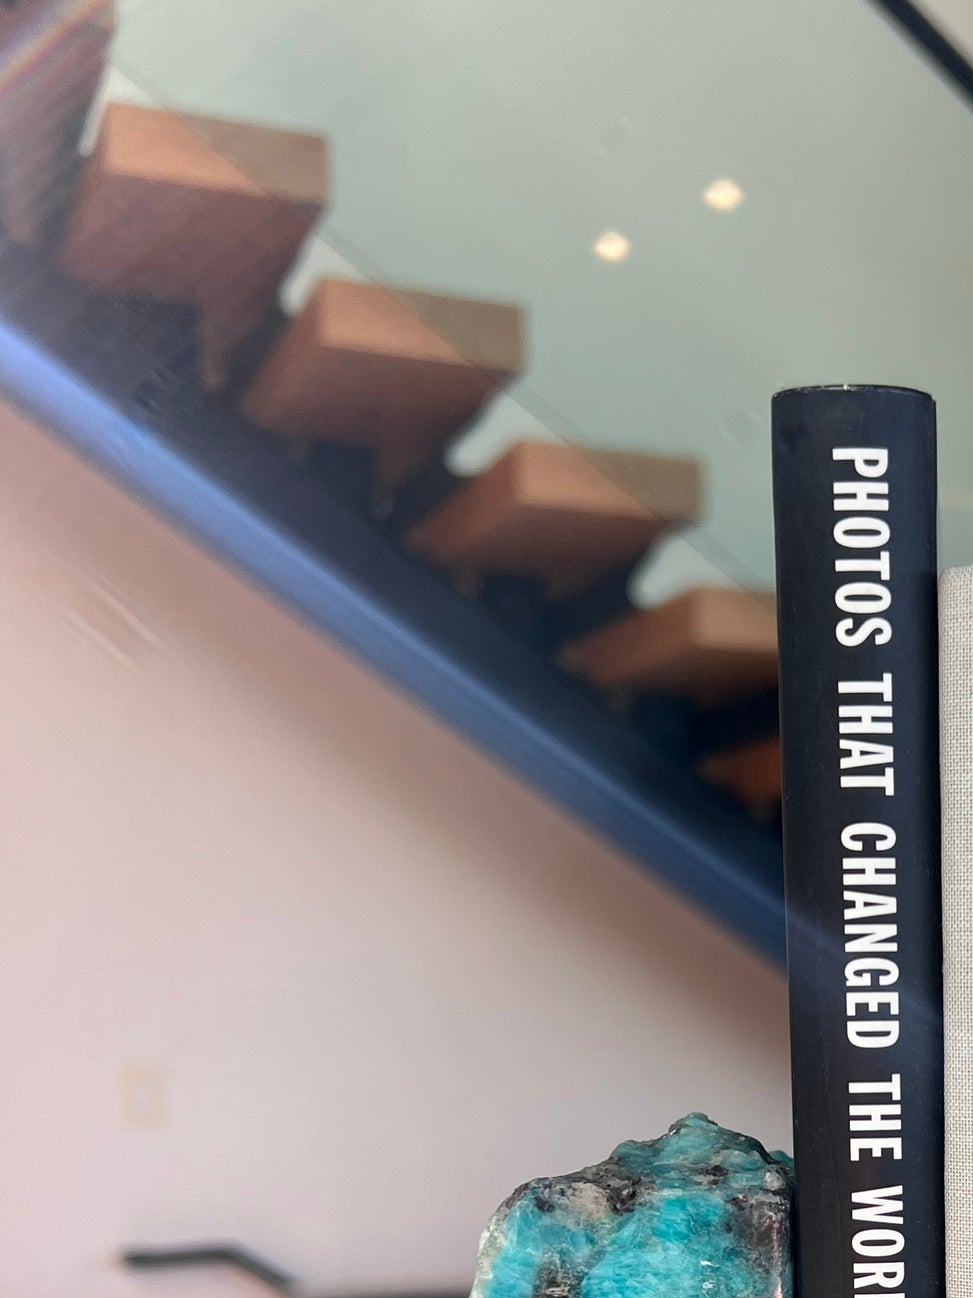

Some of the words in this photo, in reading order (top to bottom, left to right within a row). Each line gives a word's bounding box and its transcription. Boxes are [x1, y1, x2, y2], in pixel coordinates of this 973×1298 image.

[832, 447, 893, 647] PHOTOS
[837, 672, 895, 796] THAT
[840, 822, 900, 1049] CHANGED
[848, 1073, 903, 1162] THE
